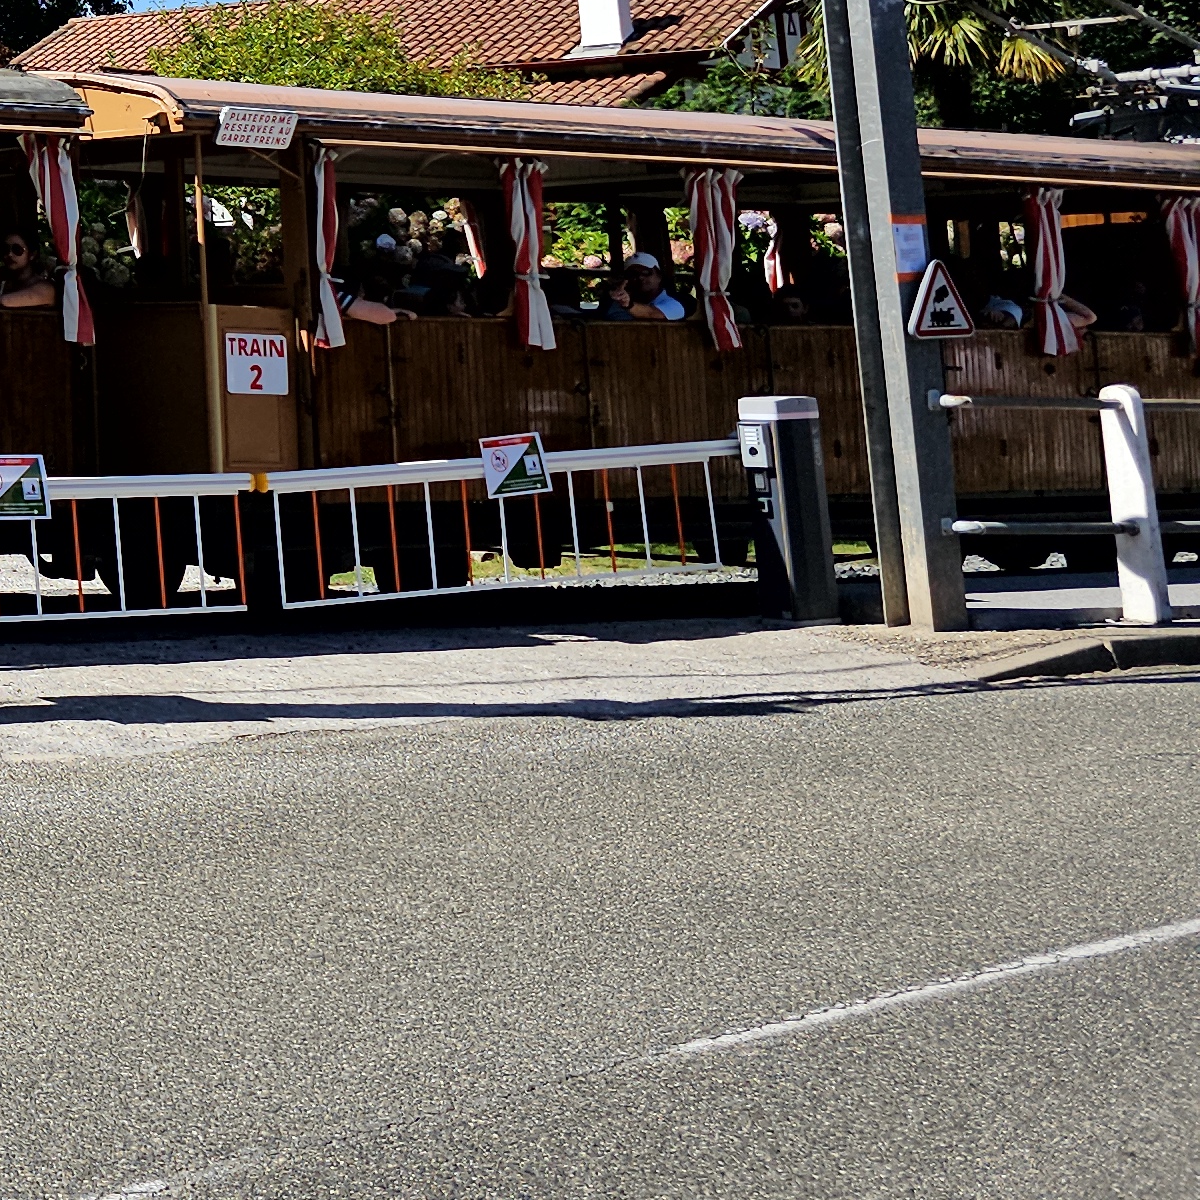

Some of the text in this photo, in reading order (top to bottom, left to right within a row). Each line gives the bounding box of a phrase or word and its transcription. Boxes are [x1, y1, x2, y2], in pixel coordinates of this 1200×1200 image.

[229, 112, 292, 124] PLATEFORME
[223, 123, 291, 135] RESERVEE AU
[221, 134, 286, 145] GARDE FREINS
[227, 337, 285, 358] TRAIN
[249, 364, 264, 391] 2
